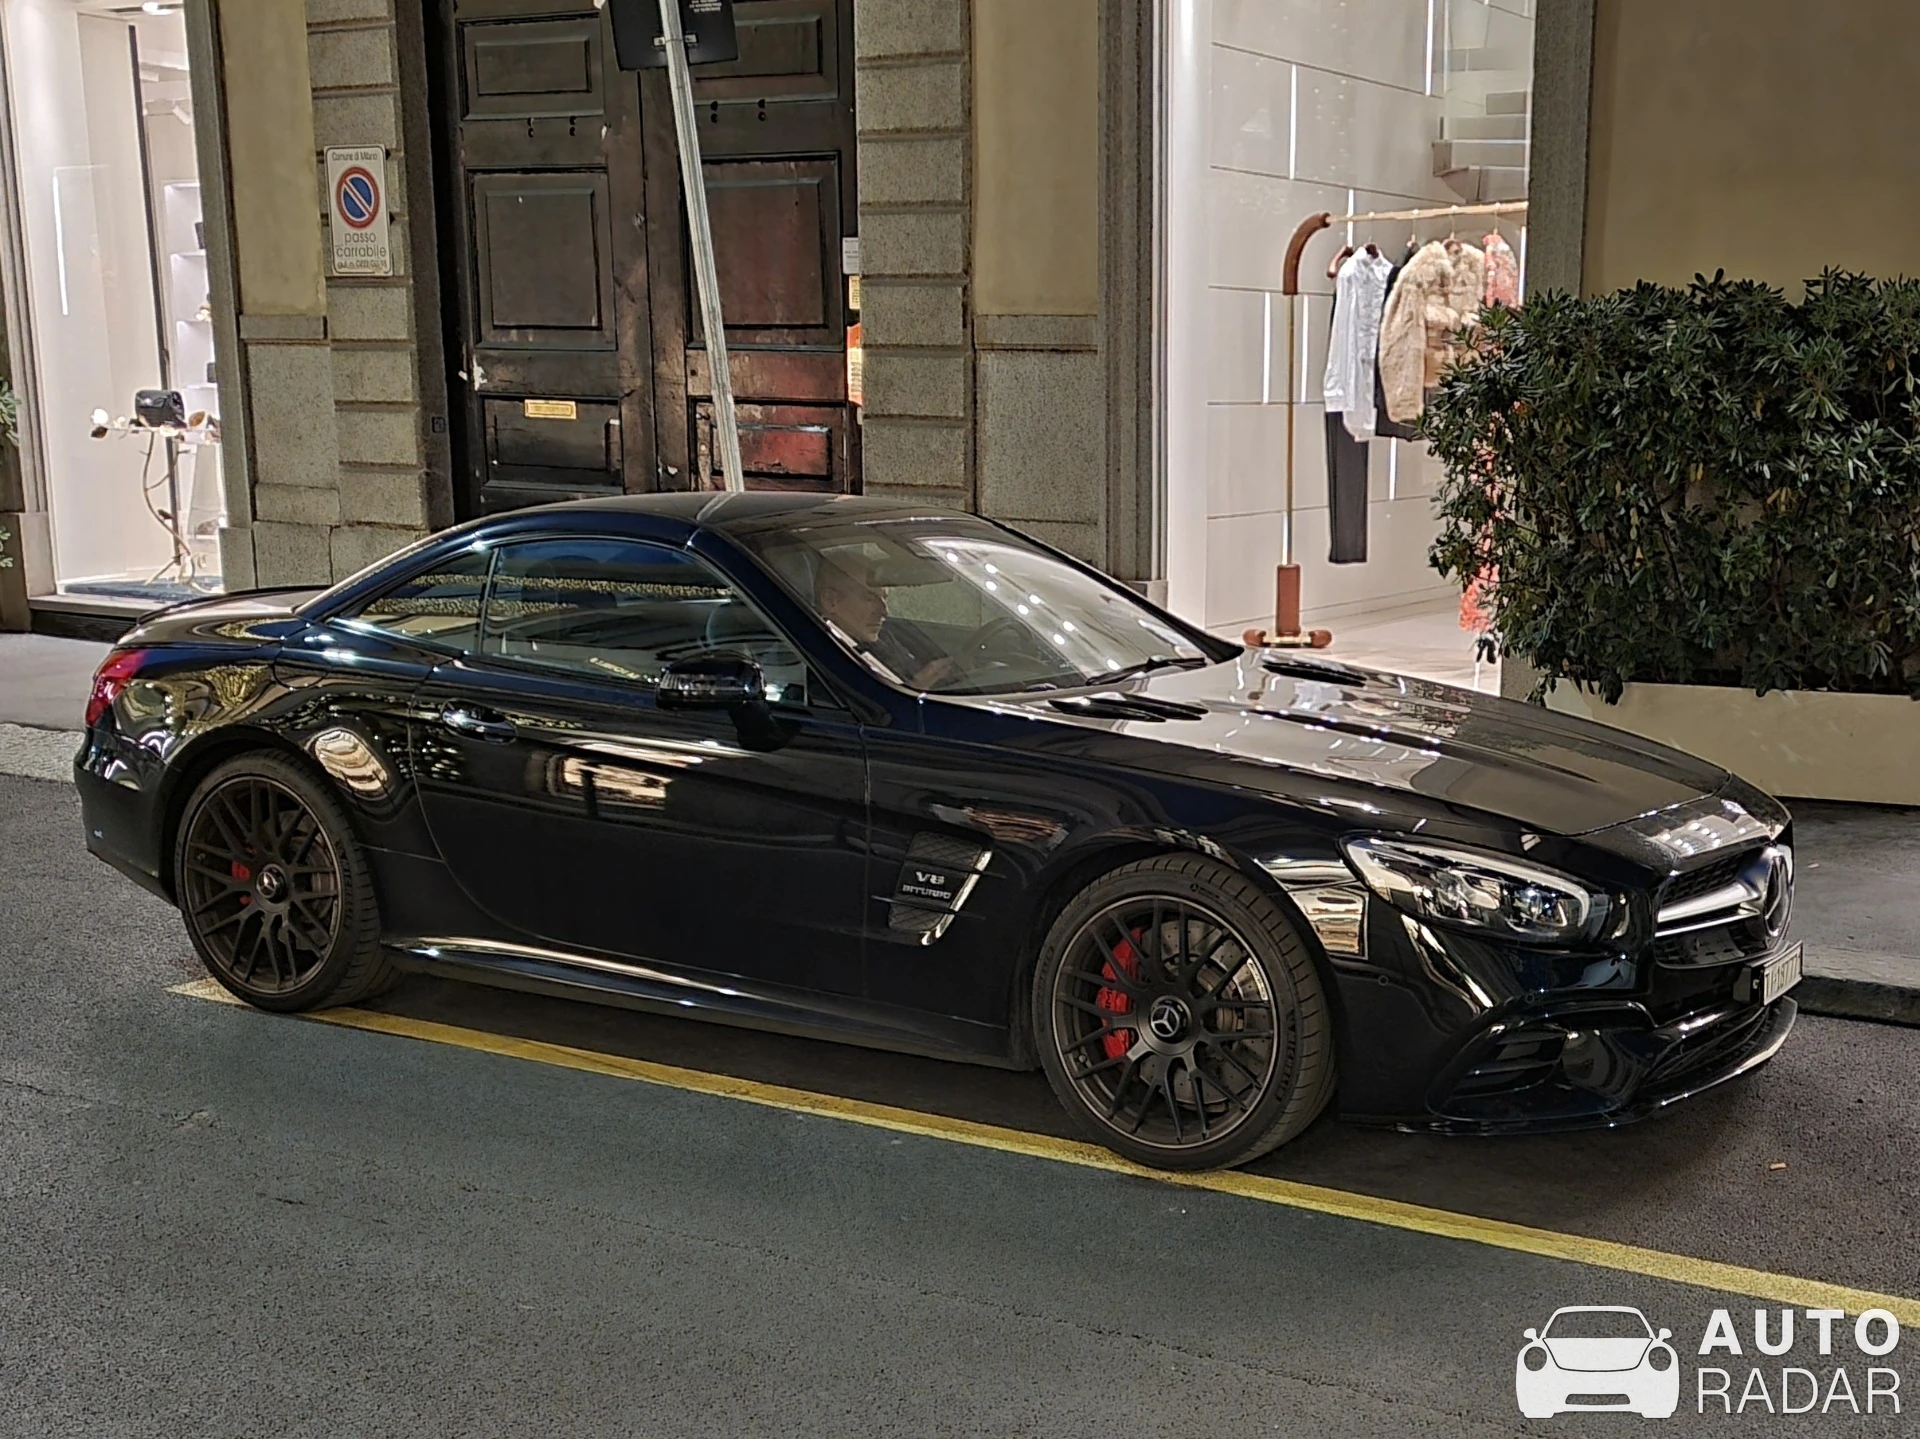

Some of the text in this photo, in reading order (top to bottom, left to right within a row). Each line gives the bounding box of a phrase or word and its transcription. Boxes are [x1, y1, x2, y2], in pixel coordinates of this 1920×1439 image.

[344, 232, 377, 245] passo
[336, 244, 387, 258] carrabile
[915, 871, 945, 885] V8
[902, 884, 952, 899] BITURBO
